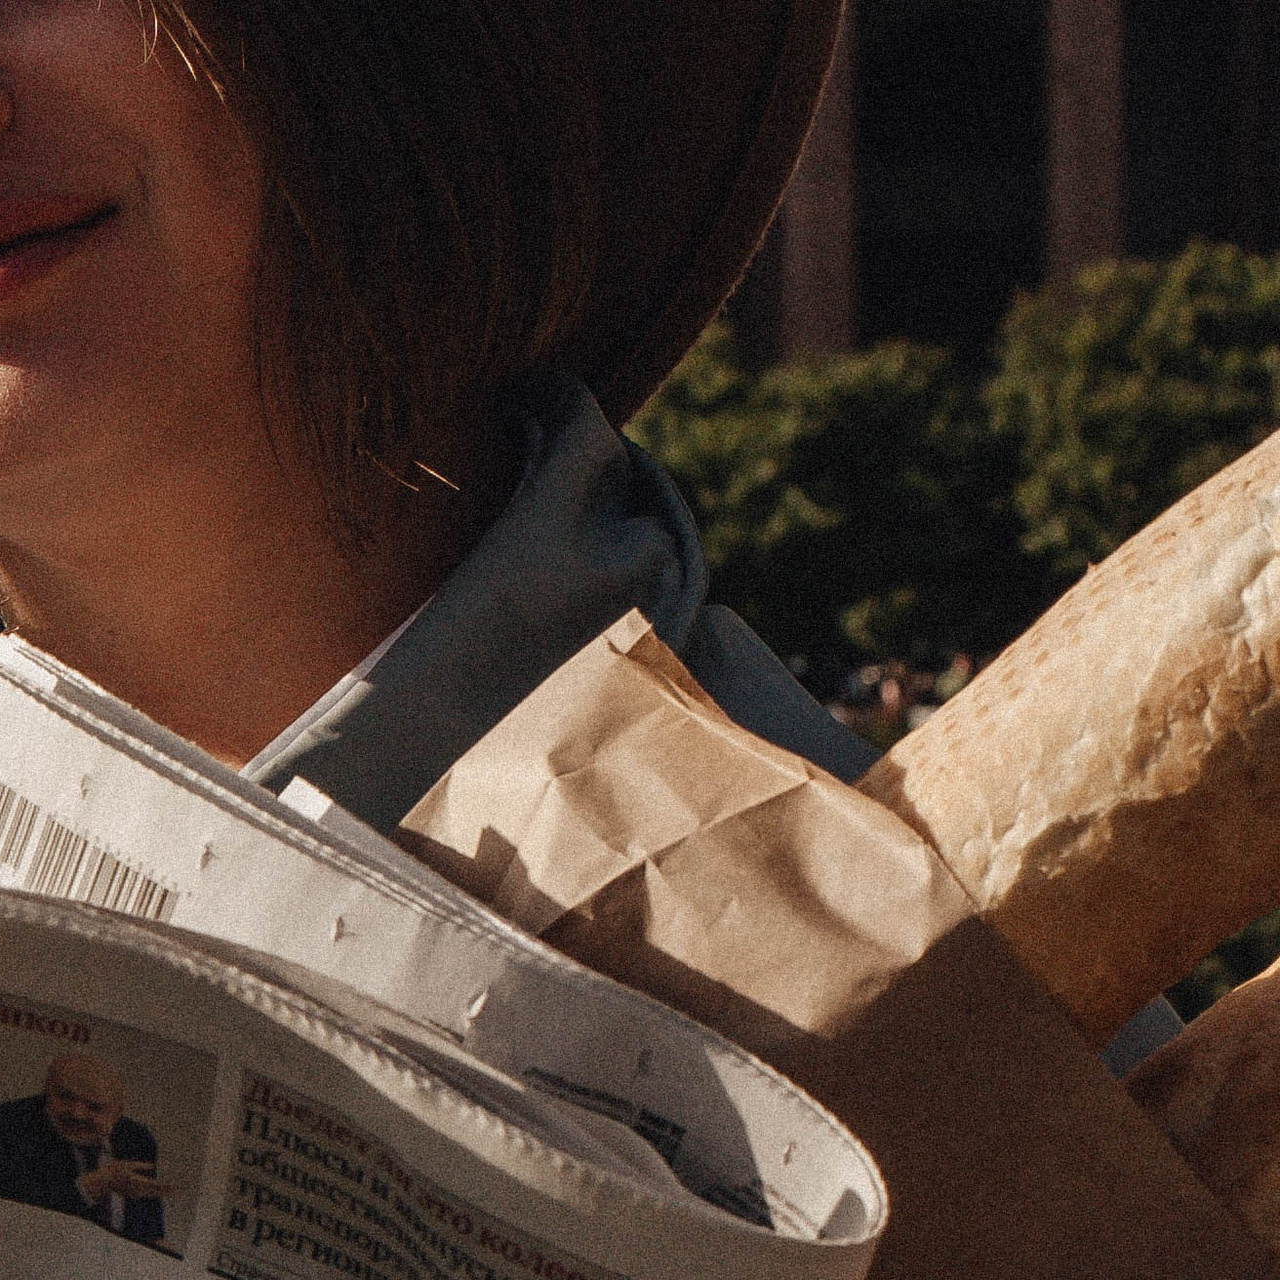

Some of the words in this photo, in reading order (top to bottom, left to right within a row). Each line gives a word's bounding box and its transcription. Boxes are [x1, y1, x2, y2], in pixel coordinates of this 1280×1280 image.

[242, 1109, 364, 1184] Плюсы
[371, 1177, 389, 1200] и
[227, 1208, 248, 1233] в
